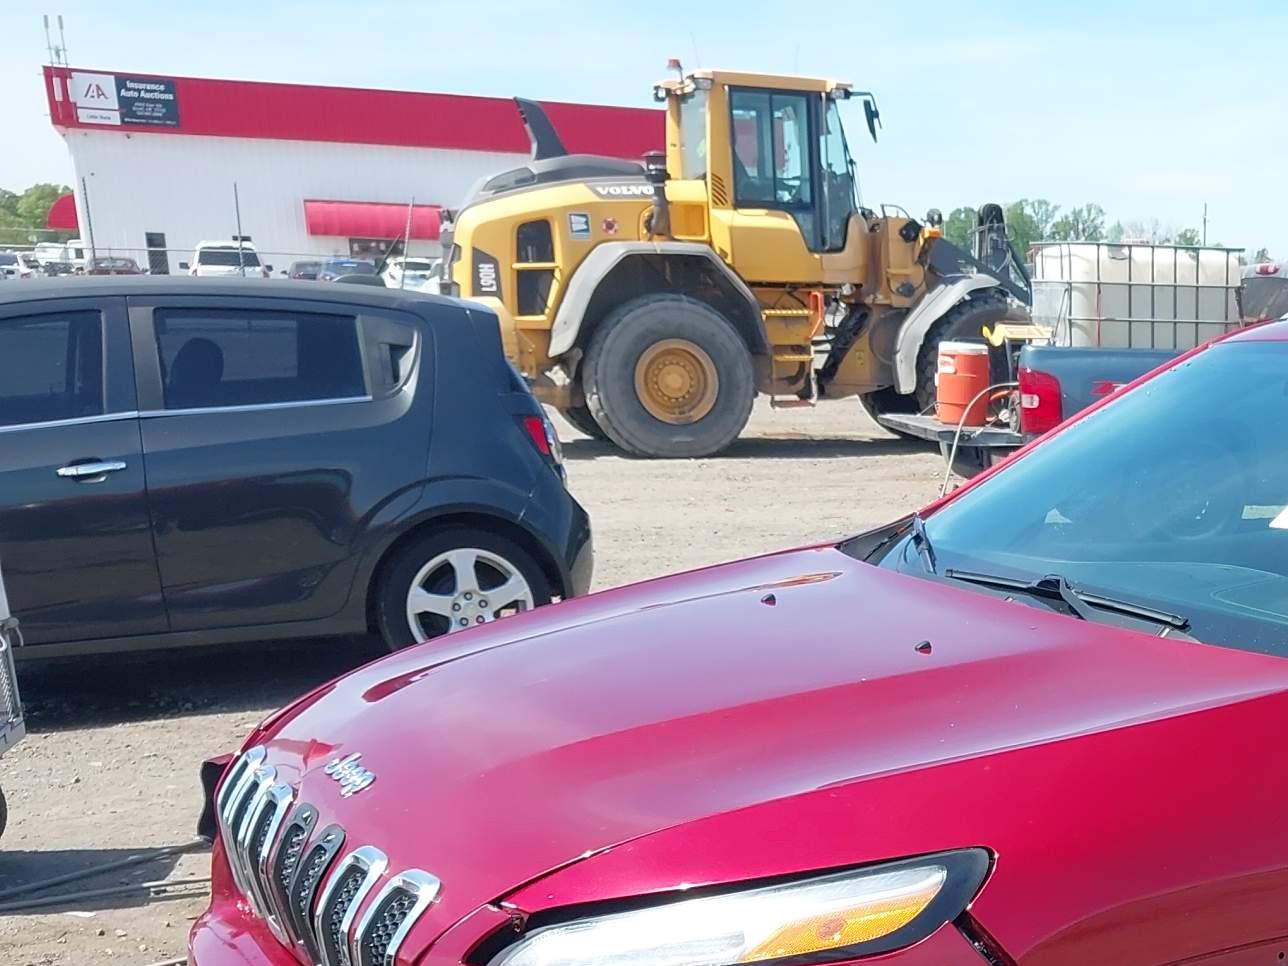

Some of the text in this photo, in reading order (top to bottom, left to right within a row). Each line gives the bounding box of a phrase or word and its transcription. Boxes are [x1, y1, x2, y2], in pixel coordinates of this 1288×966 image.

[126, 80, 166, 91] Insurance
[120, 89, 174, 101] Auto Auctions
[595, 185, 655, 195] VOLVO
[478, 264, 497, 291] L90H
[324, 752, 376, 798] Jeep
